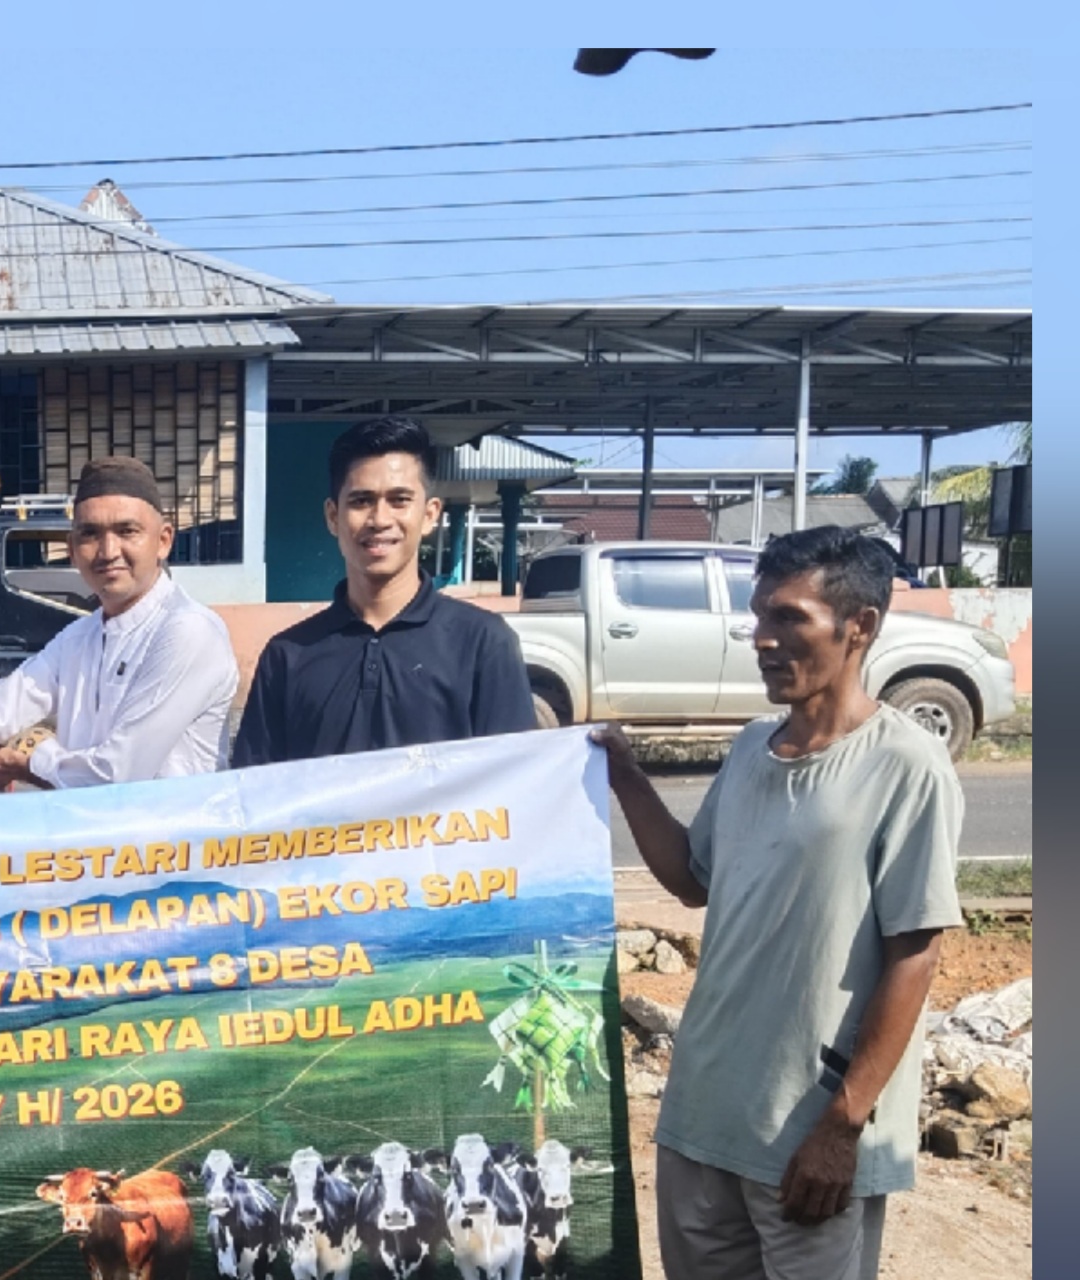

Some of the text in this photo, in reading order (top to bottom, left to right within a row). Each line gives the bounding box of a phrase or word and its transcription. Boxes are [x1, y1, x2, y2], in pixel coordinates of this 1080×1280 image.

[201, 806, 511, 868] MEMBERIKAN
[40, 886, 266, 940] DELAPAN)
[279, 876, 406, 921] EKOR
[421, 867, 518, 908] SAPI
[210, 953, 235, 987] 8
[247, 941, 374, 981] DESA
[81, 1016, 208, 1060] RAYA
[220, 1004, 353, 1048] IEDUL
[365, 990, 484, 1034] ADHA
[18, 1091, 61, 1125] H/
[73, 1079, 183, 1122] 2026
